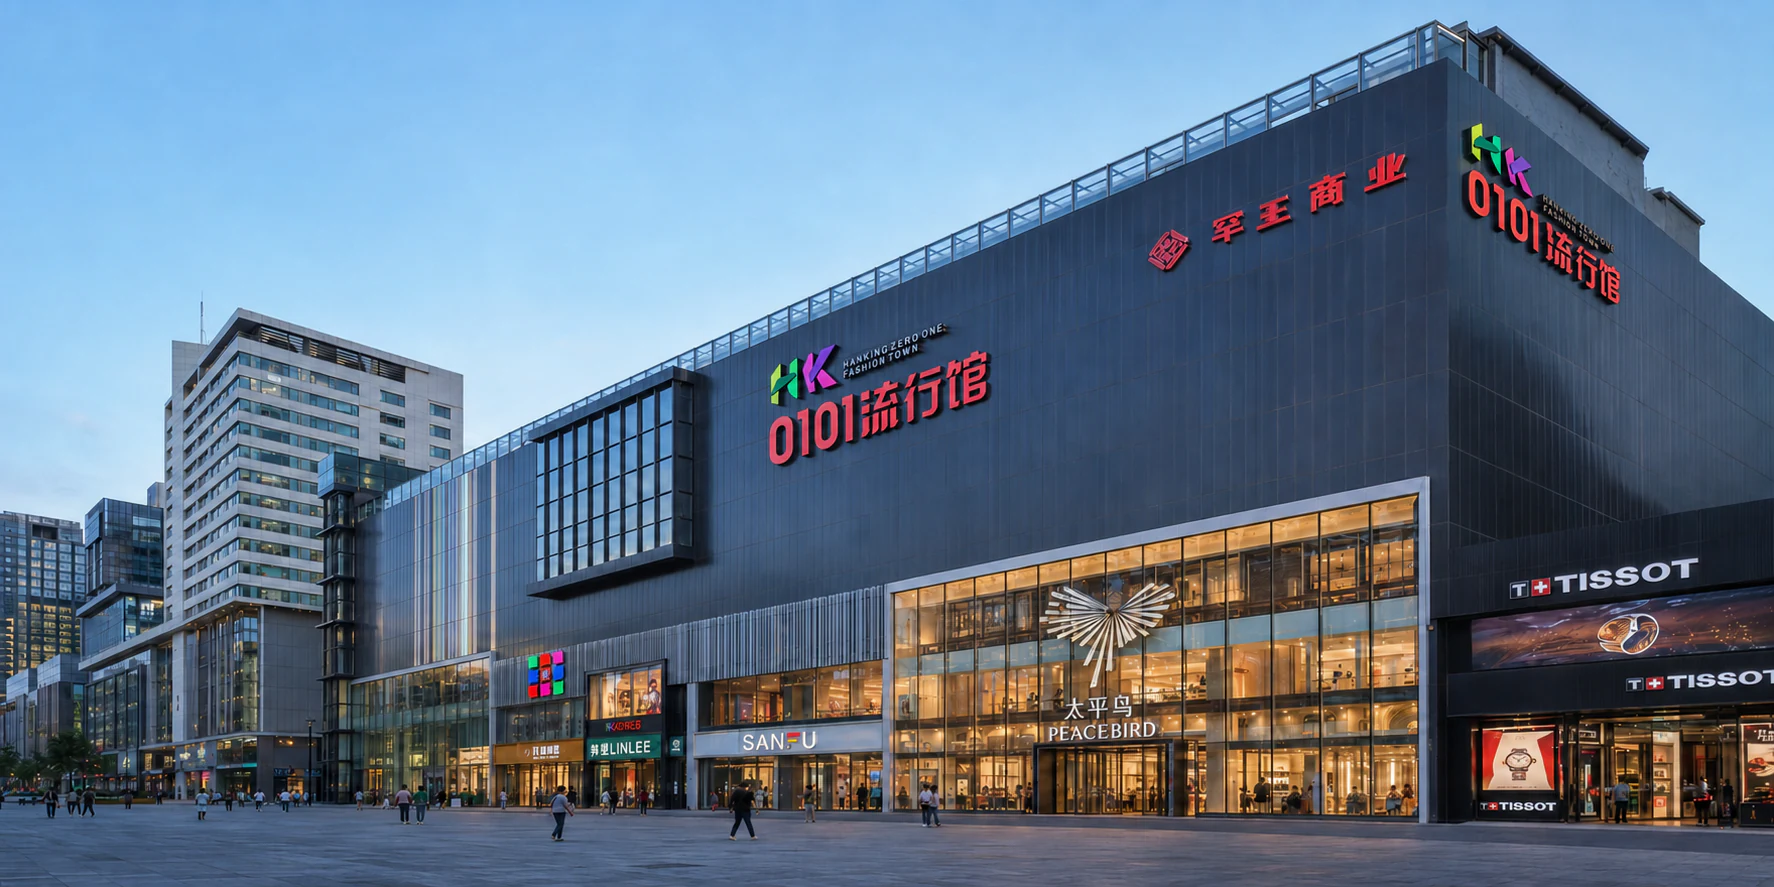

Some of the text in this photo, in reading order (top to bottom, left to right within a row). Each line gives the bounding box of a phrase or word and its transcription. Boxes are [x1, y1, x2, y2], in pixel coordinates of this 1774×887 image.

[1468, 169, 1620, 304] 0101流行馆
[843, 323, 943, 369] HANKING ZERO ONE
[843, 343, 918, 378] FASHION TOWN
[769, 350, 987, 465] 0101流行馆
[1554, 557, 1699, 593] TISSOT
[1064, 694, 1133, 720] 太平鸟
[610, 740, 651, 755] LINLEE
[1049, 721, 1156, 742] PEACEBIRD
[1499, 802, 1557, 811] TISSOT
